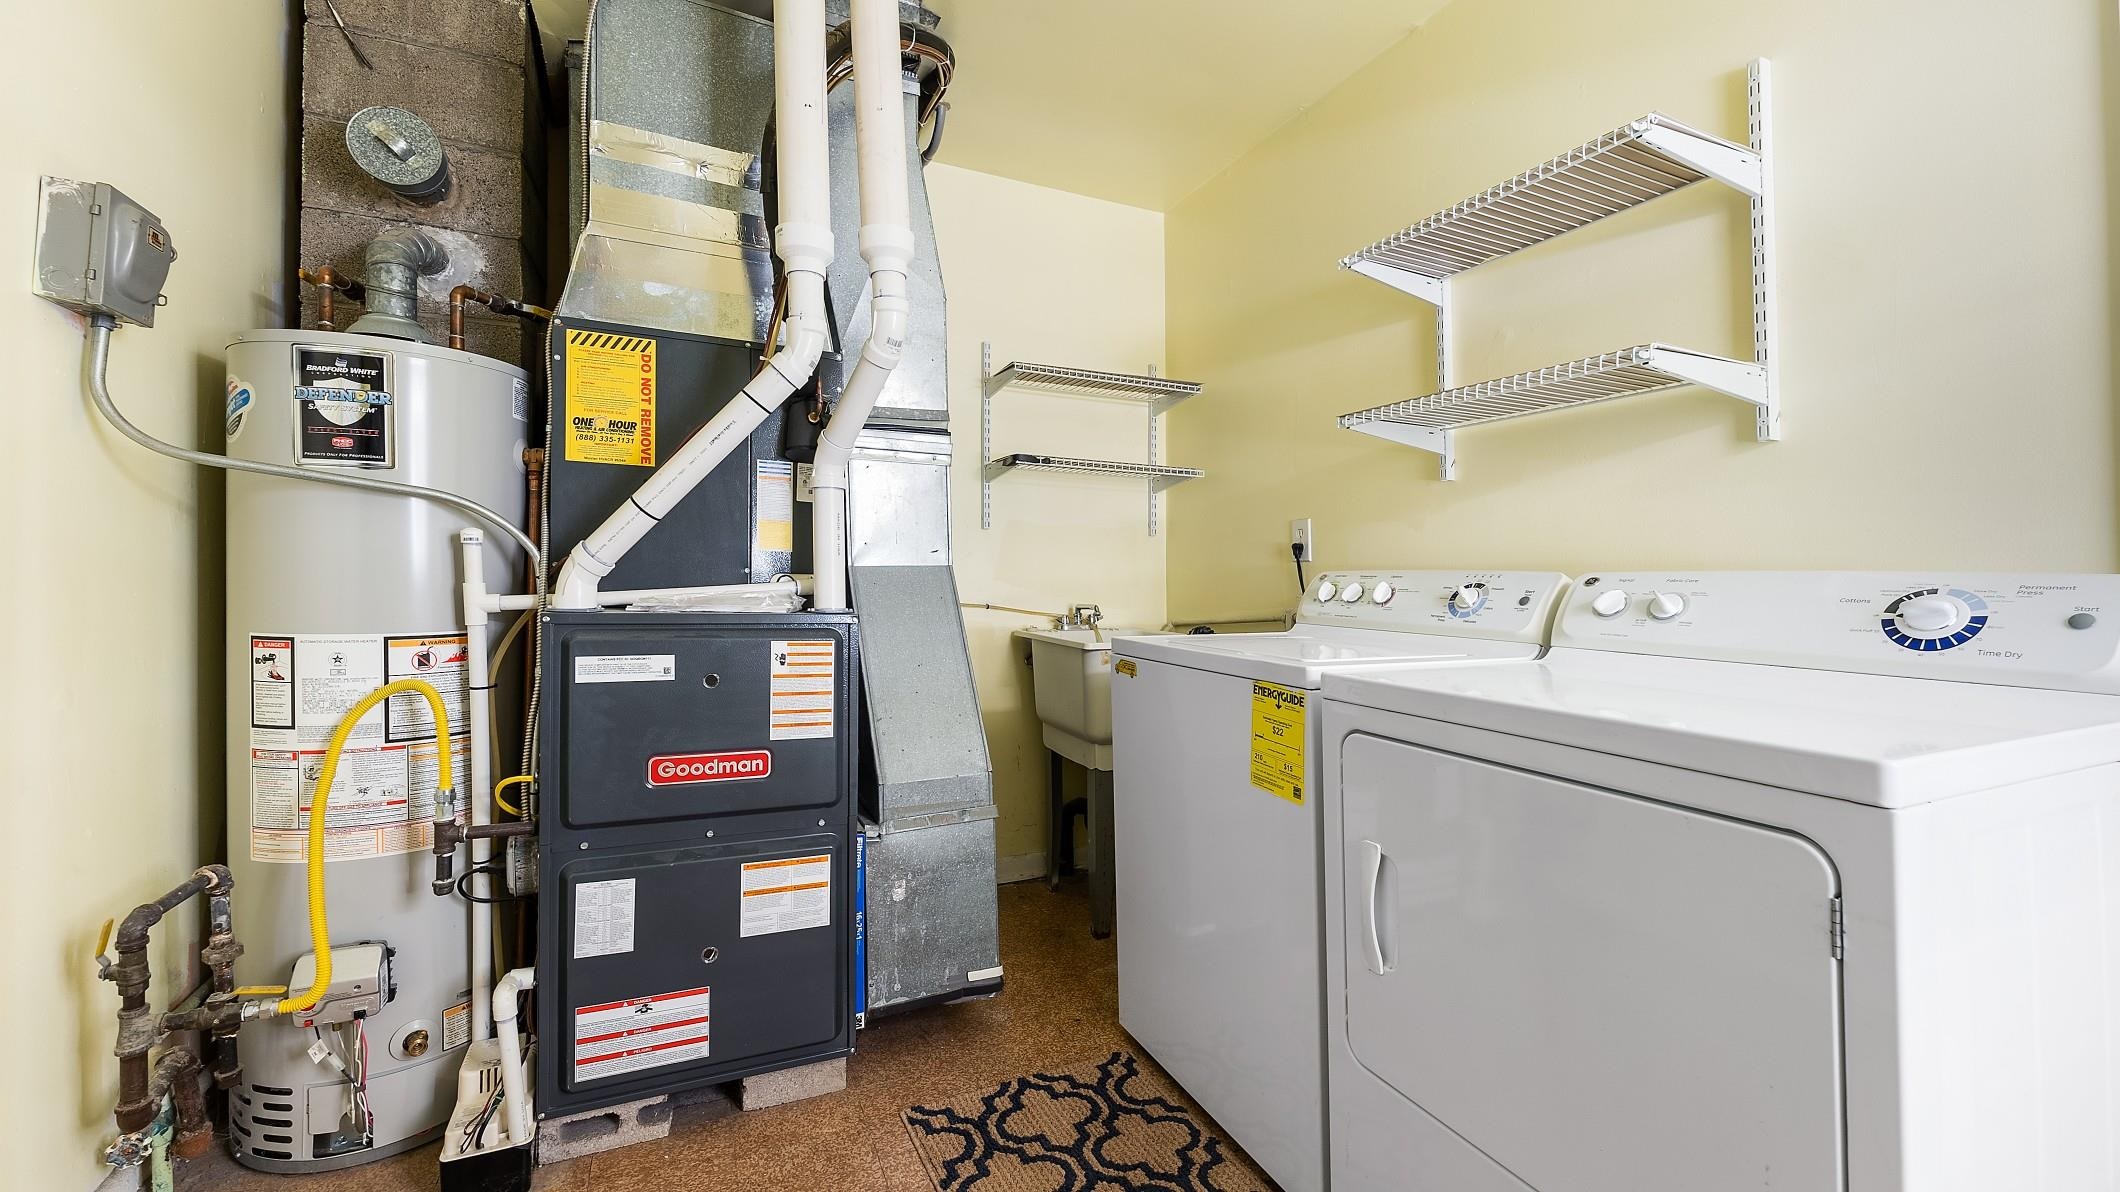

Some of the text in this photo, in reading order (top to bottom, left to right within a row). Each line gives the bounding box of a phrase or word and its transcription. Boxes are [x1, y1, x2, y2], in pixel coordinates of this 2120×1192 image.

[306, 364, 377, 376] BRADFORD WHITE
[295, 386, 392, 405] DEFENDER
[640, 353, 652, 464] DO NOT REMOVE
[572, 416, 637, 430] ONE HOUR
[575, 433, 597, 442] (888)
[599, 435, 635, 444] 335-1131
[1977, 649, 2023, 660] Time Dry
[1253, 684, 1305, 708] ENERGYGUIDE
[1272, 725, 1284, 737] $22
[657, 758, 763, 778] Goodman
[1283, 763, 1293, 772] $15
